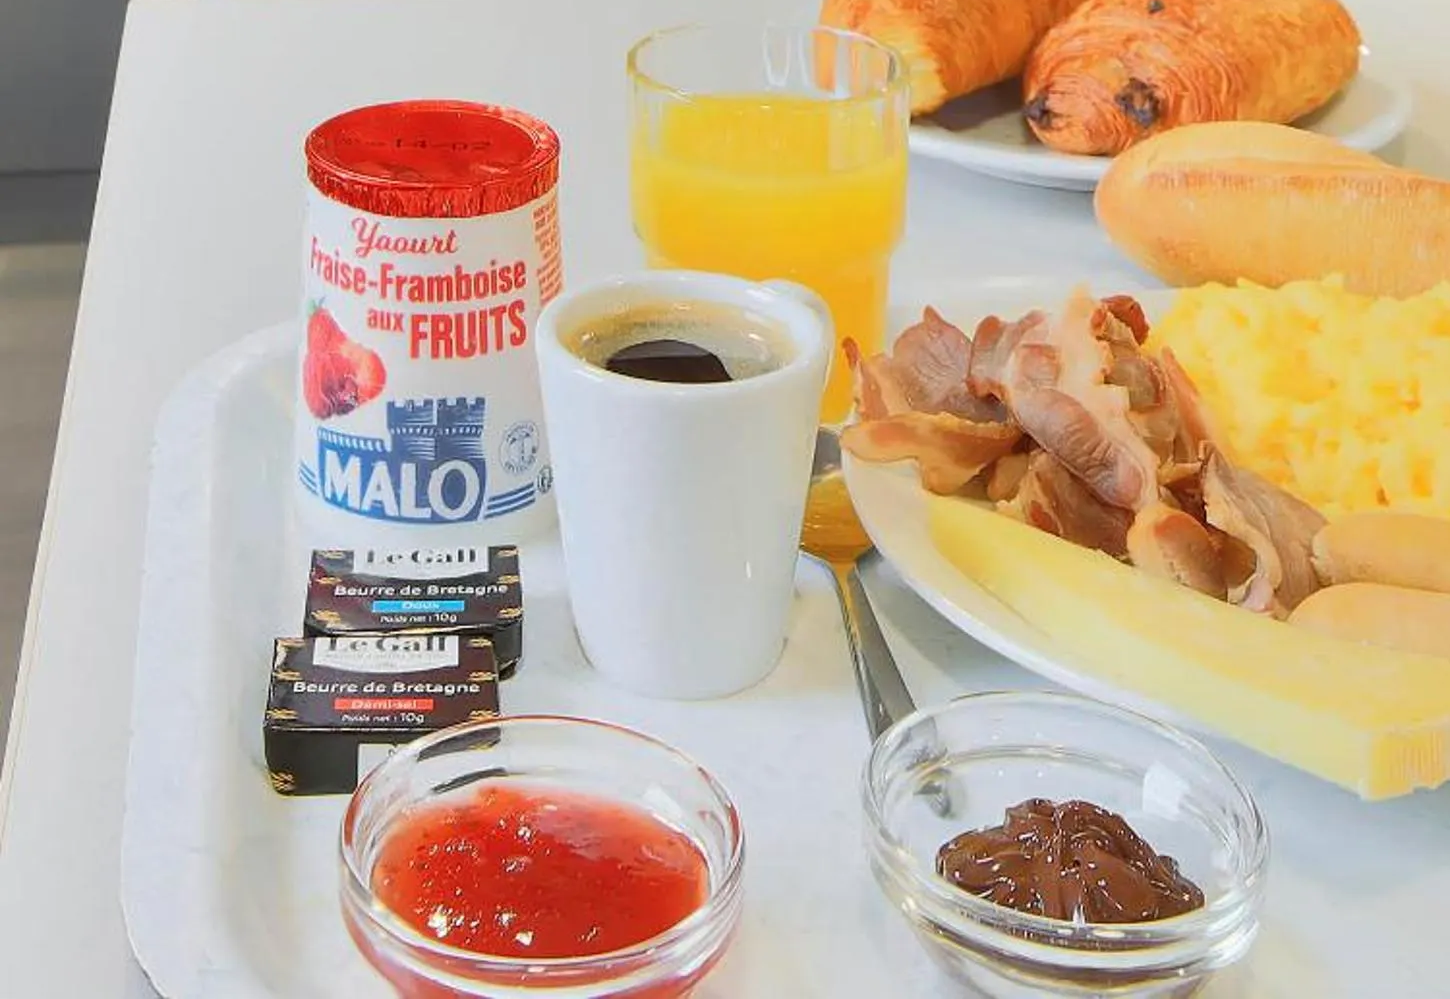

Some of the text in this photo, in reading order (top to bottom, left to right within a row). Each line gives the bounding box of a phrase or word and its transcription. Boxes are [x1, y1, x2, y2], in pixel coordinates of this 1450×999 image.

[351, 217, 459, 258] Yaourt
[311, 236, 527, 303] Fraise-Framboise
[367, 299, 527, 359] aux FRUITS
[324, 449, 481, 520] MALO
[333, 583, 509, 597] Beurre de Bretagne
[434, 613, 458, 624] 10g
[293, 681, 480, 696] Beurre de Bretagne
[399, 712, 425, 724] 10g
